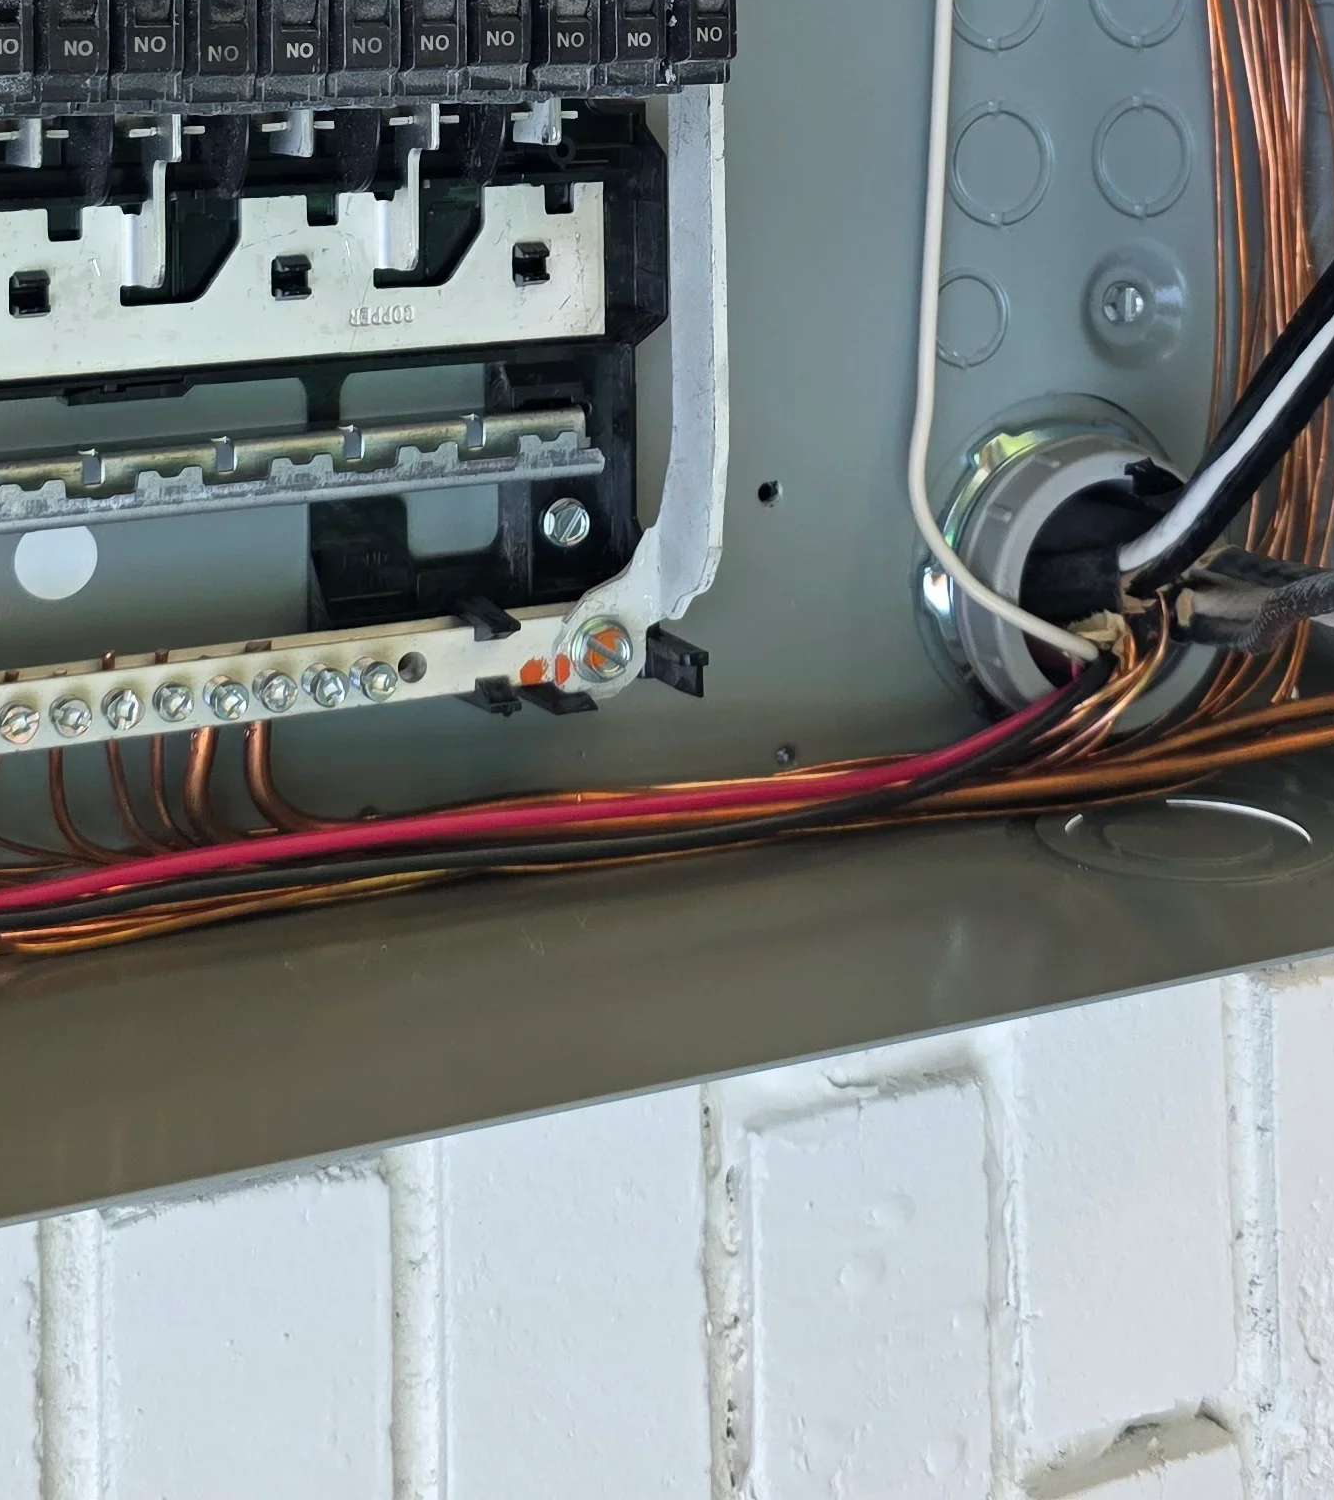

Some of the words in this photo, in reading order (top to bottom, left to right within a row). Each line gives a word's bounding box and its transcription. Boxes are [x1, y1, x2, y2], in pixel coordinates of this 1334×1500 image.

[421, 34, 450, 50] ON
[486, 30, 515, 47] ON
[557, 31, 585, 48] ON
[628, 32, 652, 47] ON
[697, 26, 723, 42] ON
[64, 40, 93, 57] ON
[134, 36, 167, 53] ON
[286, 42, 314, 59] ON
[352, 37, 382, 54] ON
[208, 45, 239, 62] ON
[349, 305, 415, 328] COPPER
